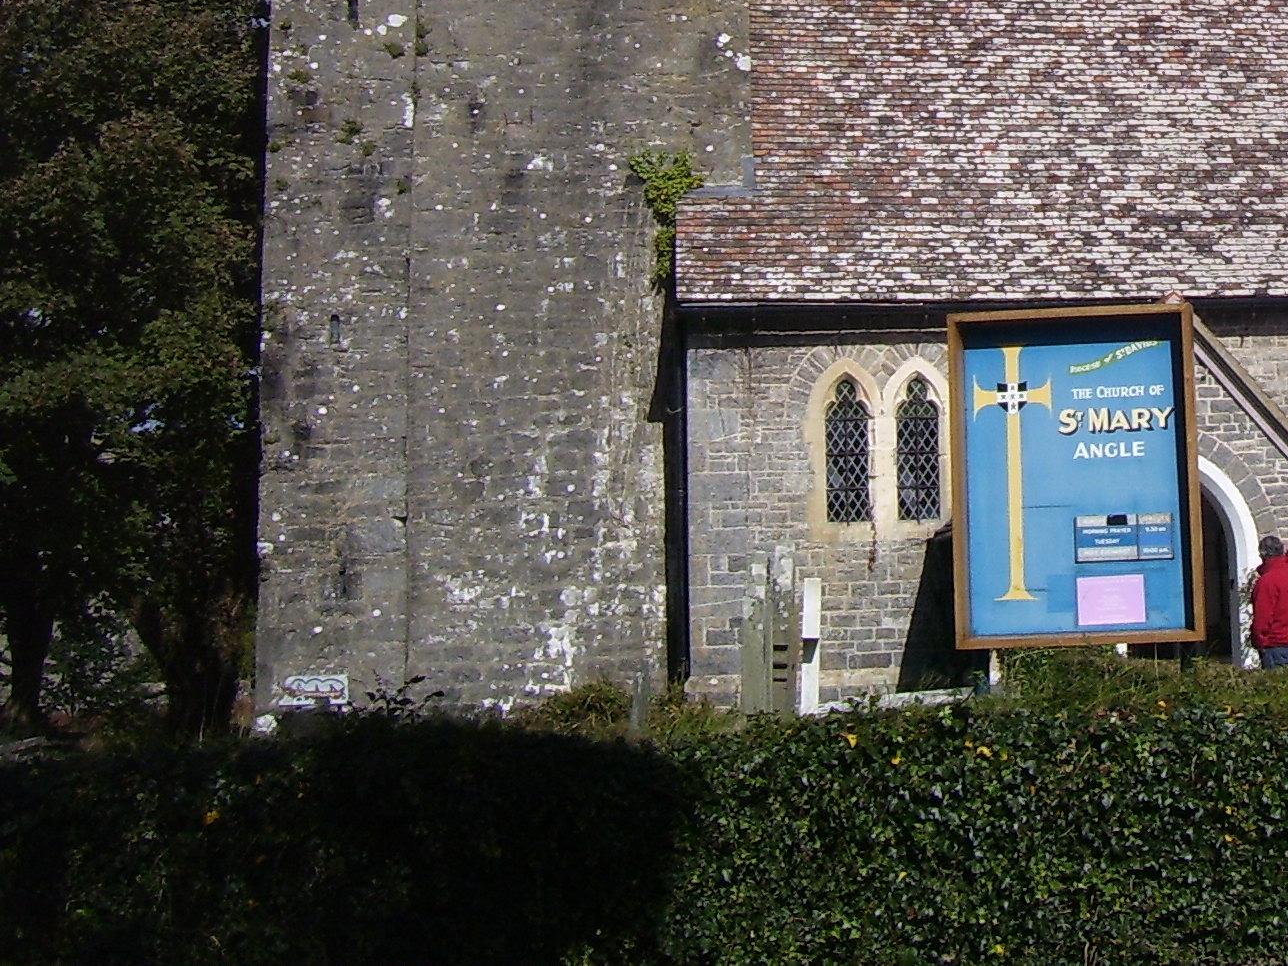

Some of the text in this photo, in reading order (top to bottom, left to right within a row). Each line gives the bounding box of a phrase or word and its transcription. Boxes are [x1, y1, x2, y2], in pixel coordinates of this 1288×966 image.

[1072, 384, 1165, 400] THE CHURCH OF
[1088, 406, 1174, 433] MARY
[1073, 441, 1145, 459] ANGLE
